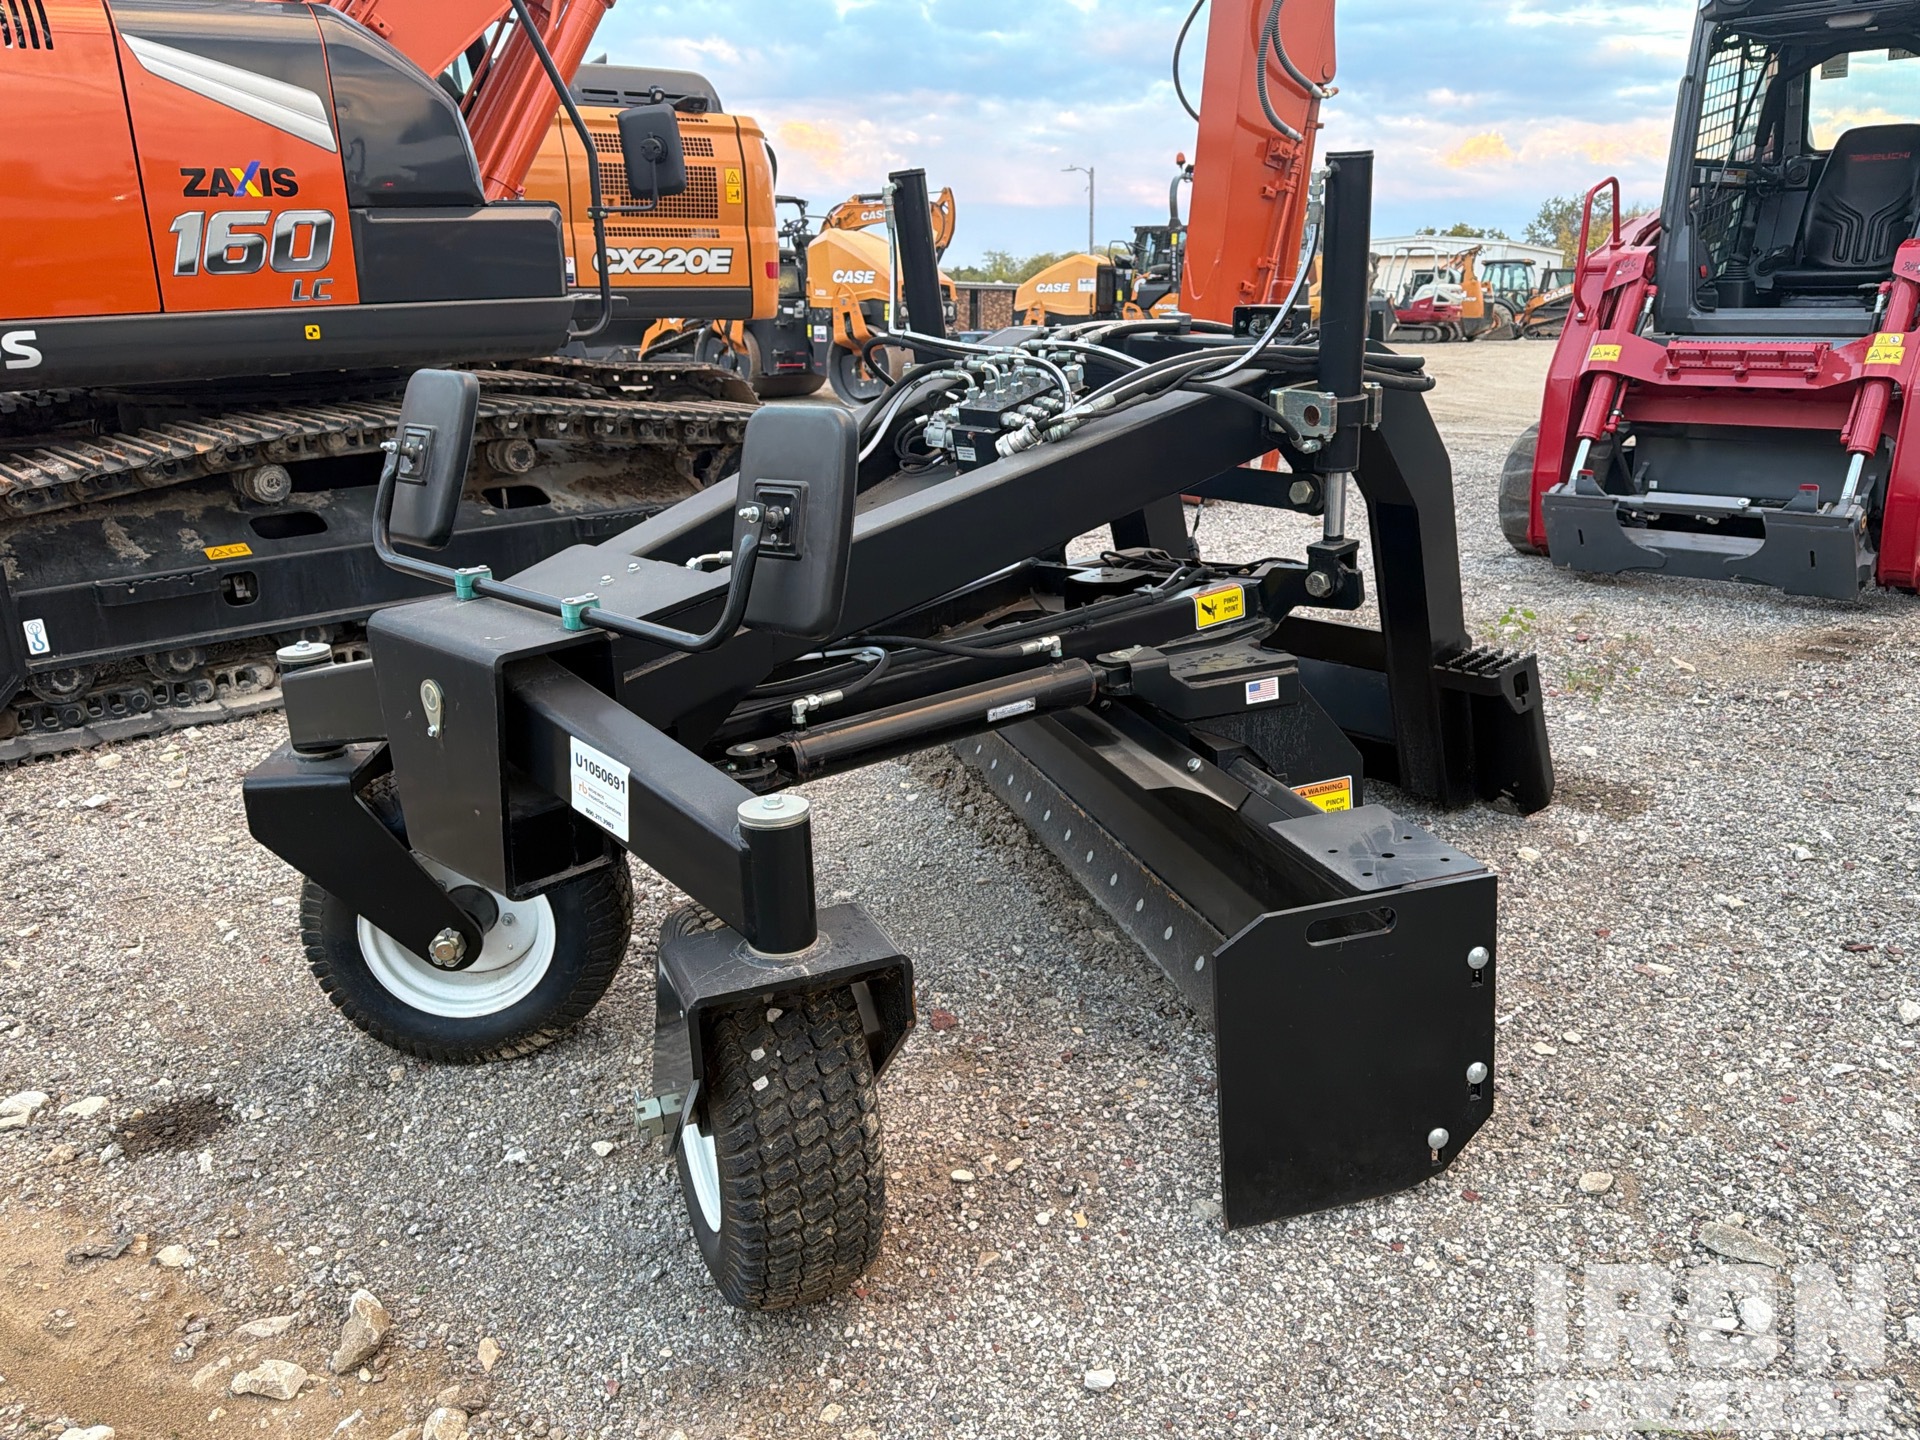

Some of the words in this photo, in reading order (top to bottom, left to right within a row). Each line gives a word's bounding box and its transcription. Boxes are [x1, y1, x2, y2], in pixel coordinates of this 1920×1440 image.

[180, 161, 299, 197] ZAXIS
[169, 209, 335, 276] 160
[592, 247, 733, 274] CX220E
[832, 269, 876, 284] CASE
[291, 278, 334, 301] LC
[1036, 283, 1071, 293] CASE
[1223, 595, 1239, 605] PINCH
[1223, 604, 1239, 613] POINT
[575, 752, 625, 794] U1050691
[1308, 782, 1343, 795] WARNING
[1326, 797, 1345, 806] PINCH
